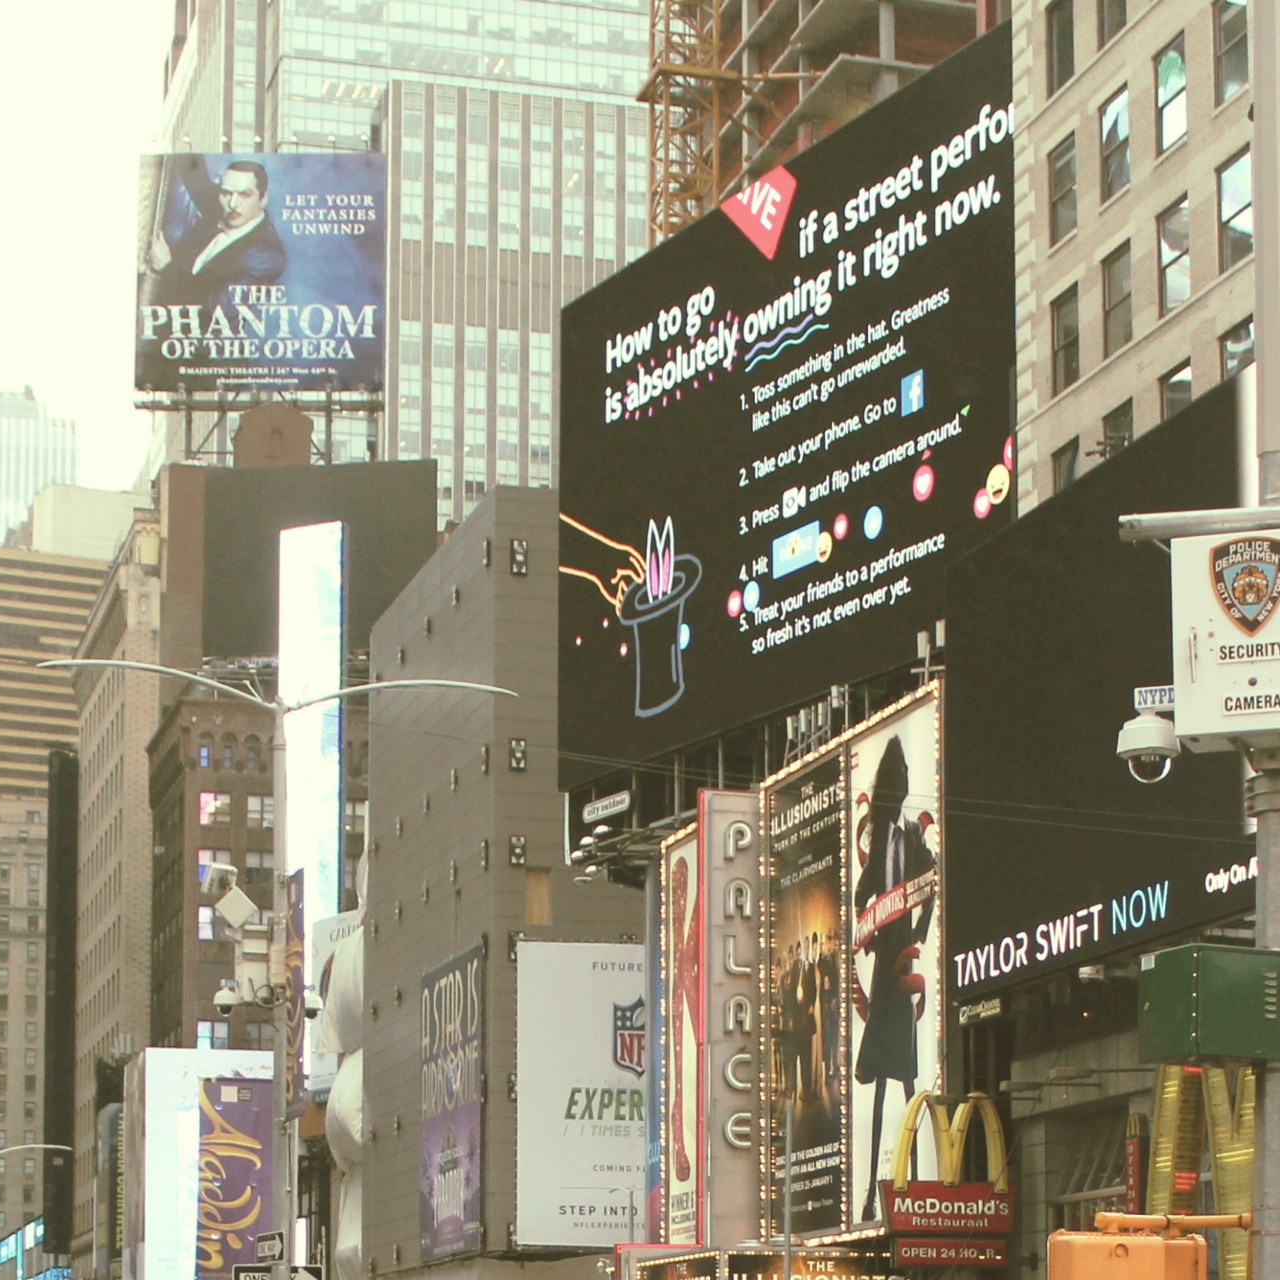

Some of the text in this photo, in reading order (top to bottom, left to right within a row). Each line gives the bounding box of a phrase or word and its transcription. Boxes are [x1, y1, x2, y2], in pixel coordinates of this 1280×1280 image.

[285, 194, 375, 207] LET YOUR
[737, 180, 782, 231] IVE
[799, 215, 818, 259] if
[822, 217, 839, 244] a
[844, 154, 923, 232] street
[282, 208, 376, 221] FANTASIES
[292, 223, 366, 236] UNWIND
[228, 284, 287, 305] THE
[604, 174, 1002, 425] is absolutely owning it right now.
[139, 304, 378, 341] PHANTOM
[604, 286, 716, 374] How to go
[161, 339, 356, 360] OF THE OPERA
[752, 381, 776, 404] Toss
[777, 353, 832, 393] something
[833, 343, 844, 362] in
[846, 333, 866, 356] the
[868, 320, 889, 344] hat.
[891, 287, 950, 331] Greatness
[230, 366, 269, 375] THEATRE
[752, 335, 907, 432] like this can't go unrewarded.
[752, 456, 776, 480] Take
[777, 445, 796, 468] out
[797, 432, 822, 464] your
[825, 415, 862, 450] phone.
[864, 402, 881, 425] Go
[883, 397, 897, 414] to
[752, 504, 779, 528] Press
[809, 475, 829, 502] and
[831, 470, 849, 493] flip
[851, 461, 870, 483] the
[872, 441, 915, 472] camera
[917, 413, 962, 451] around.
[1229, 541, 1271, 555] POLICE
[752, 555, 769, 578] Hit
[753, 602, 779, 626] Treat
[780, 592, 805, 620] your
[807, 572, 844, 603] friends
[845, 570, 858, 587] to
[860, 566, 869, 582] a
[870, 533, 946, 583] performance
[1217, 582, 1232, 605] CITY
[1230, 607, 1242, 619] OF
[1257, 600, 1274, 622] NEW
[751, 576, 912, 654] so fresh it's not even over yet.
[1137, 687, 1174, 707] NYPD
[801, 782, 814, 799] THE
[586, 793, 628, 818] city outdoor
[799, 828, 811, 839] THE
[781, 875, 791, 889] THE
[1205, 870, 1229, 894] Only
[1230, 865, 1246, 886] On
[856, 887, 905, 944] FINAL MONTHS
[954, 880, 1169, 988] TAYLOR SWIFT NOW
[592, 961, 643, 972] FUTURE
[723, 820, 753, 1150] PALACE
[433, 969, 463, 1055] STAR
[467, 957, 478, 1037] IS
[563, 1087, 644, 1122] EXPER
[590, 1125, 631, 1137] TIMES
[592, 1164, 632, 1173] COMING
[559, 1205, 597, 1217] STEP
[893, 1197, 1009, 1217] McDonald's
[912, 1217, 989, 1228] Restaurant
[901, 1247, 956, 1259] OPEN 24
[807, 1260, 836, 1273] THE
